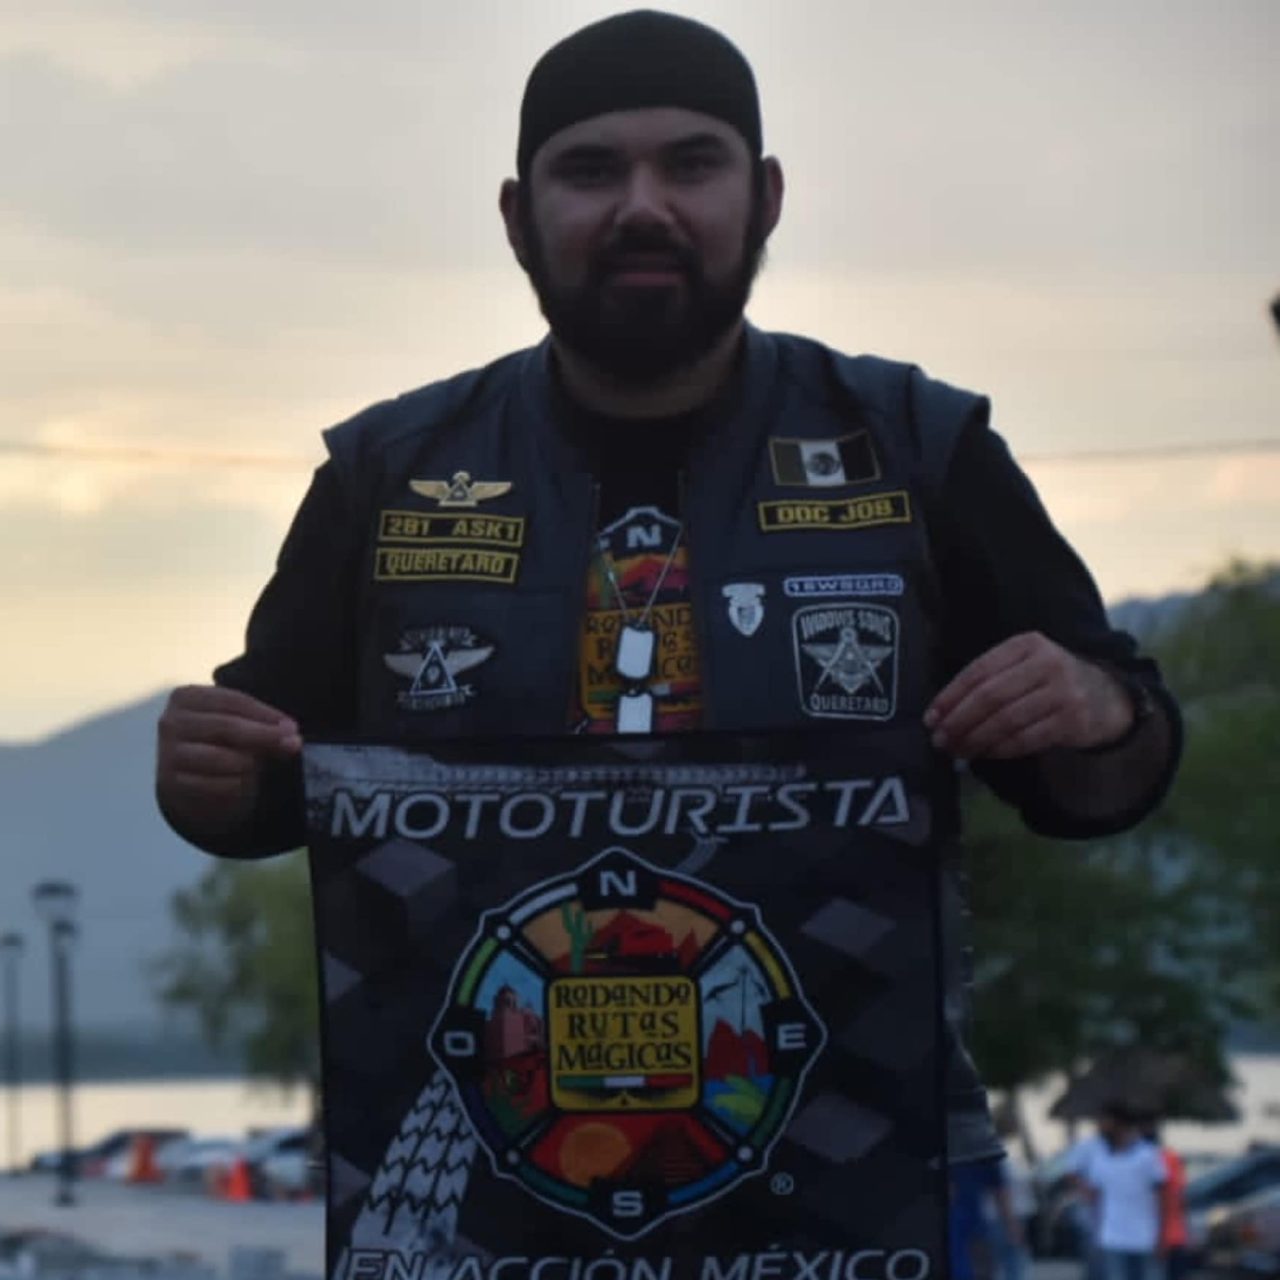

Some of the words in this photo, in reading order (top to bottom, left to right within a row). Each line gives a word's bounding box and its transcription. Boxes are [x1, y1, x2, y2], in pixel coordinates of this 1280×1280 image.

[776, 505, 830, 523] DOC
[839, 500, 894, 522] JOB
[384, 551, 506, 575] QUERETARO
[330, 776, 911, 840] MOTOTURISTA
[600, 870, 638, 897] N
